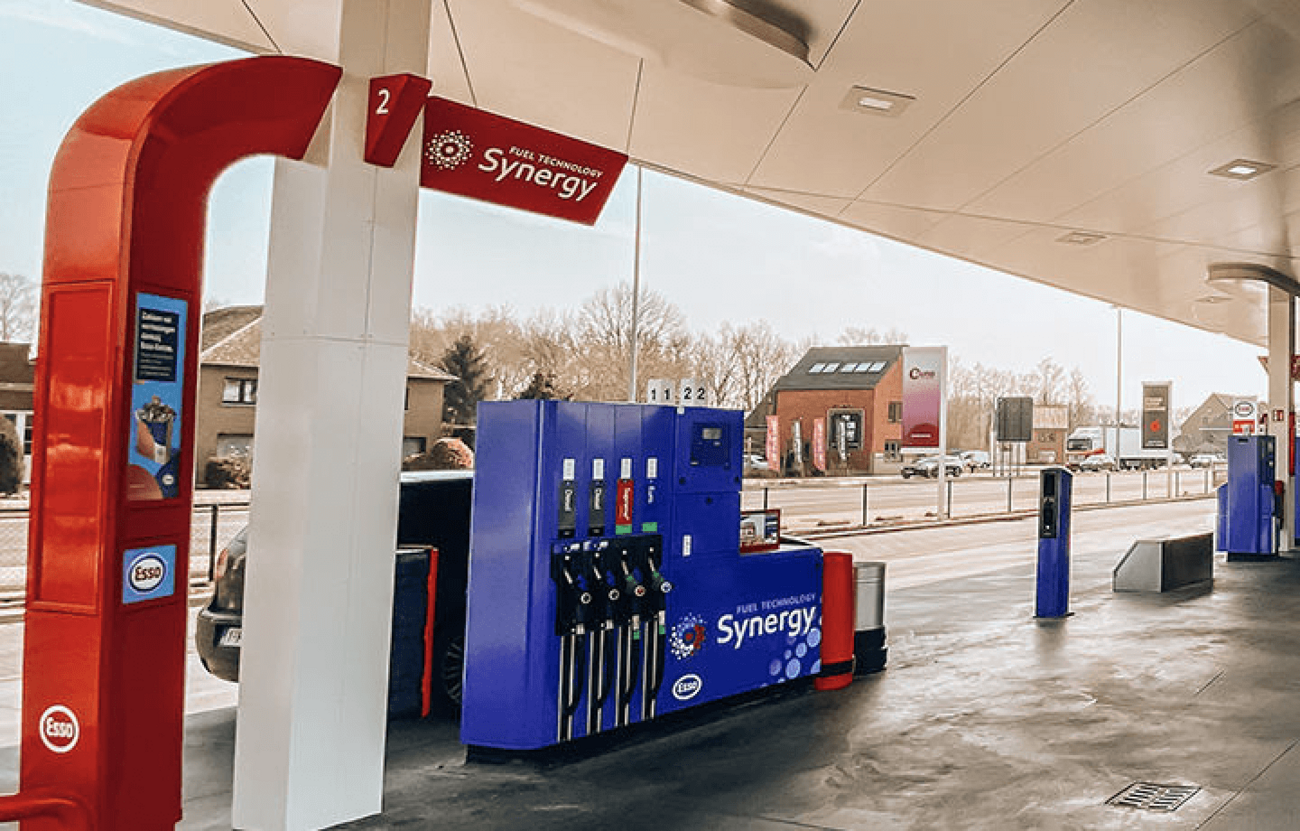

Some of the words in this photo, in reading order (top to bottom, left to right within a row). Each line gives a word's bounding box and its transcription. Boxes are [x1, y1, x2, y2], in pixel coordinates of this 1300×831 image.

[375, 88, 391, 115] 2
[508, 145, 536, 162] FUEL
[537, 153, 604, 179] TECHNOLOGY
[477, 147, 598, 202] Synergy
[134, 565, 162, 582] Esso
[736, 602, 758, 614] FUEL
[716, 606, 817, 650] Synergy
[677, 680, 699, 694] Esso
[46, 716, 73, 738] Esso
